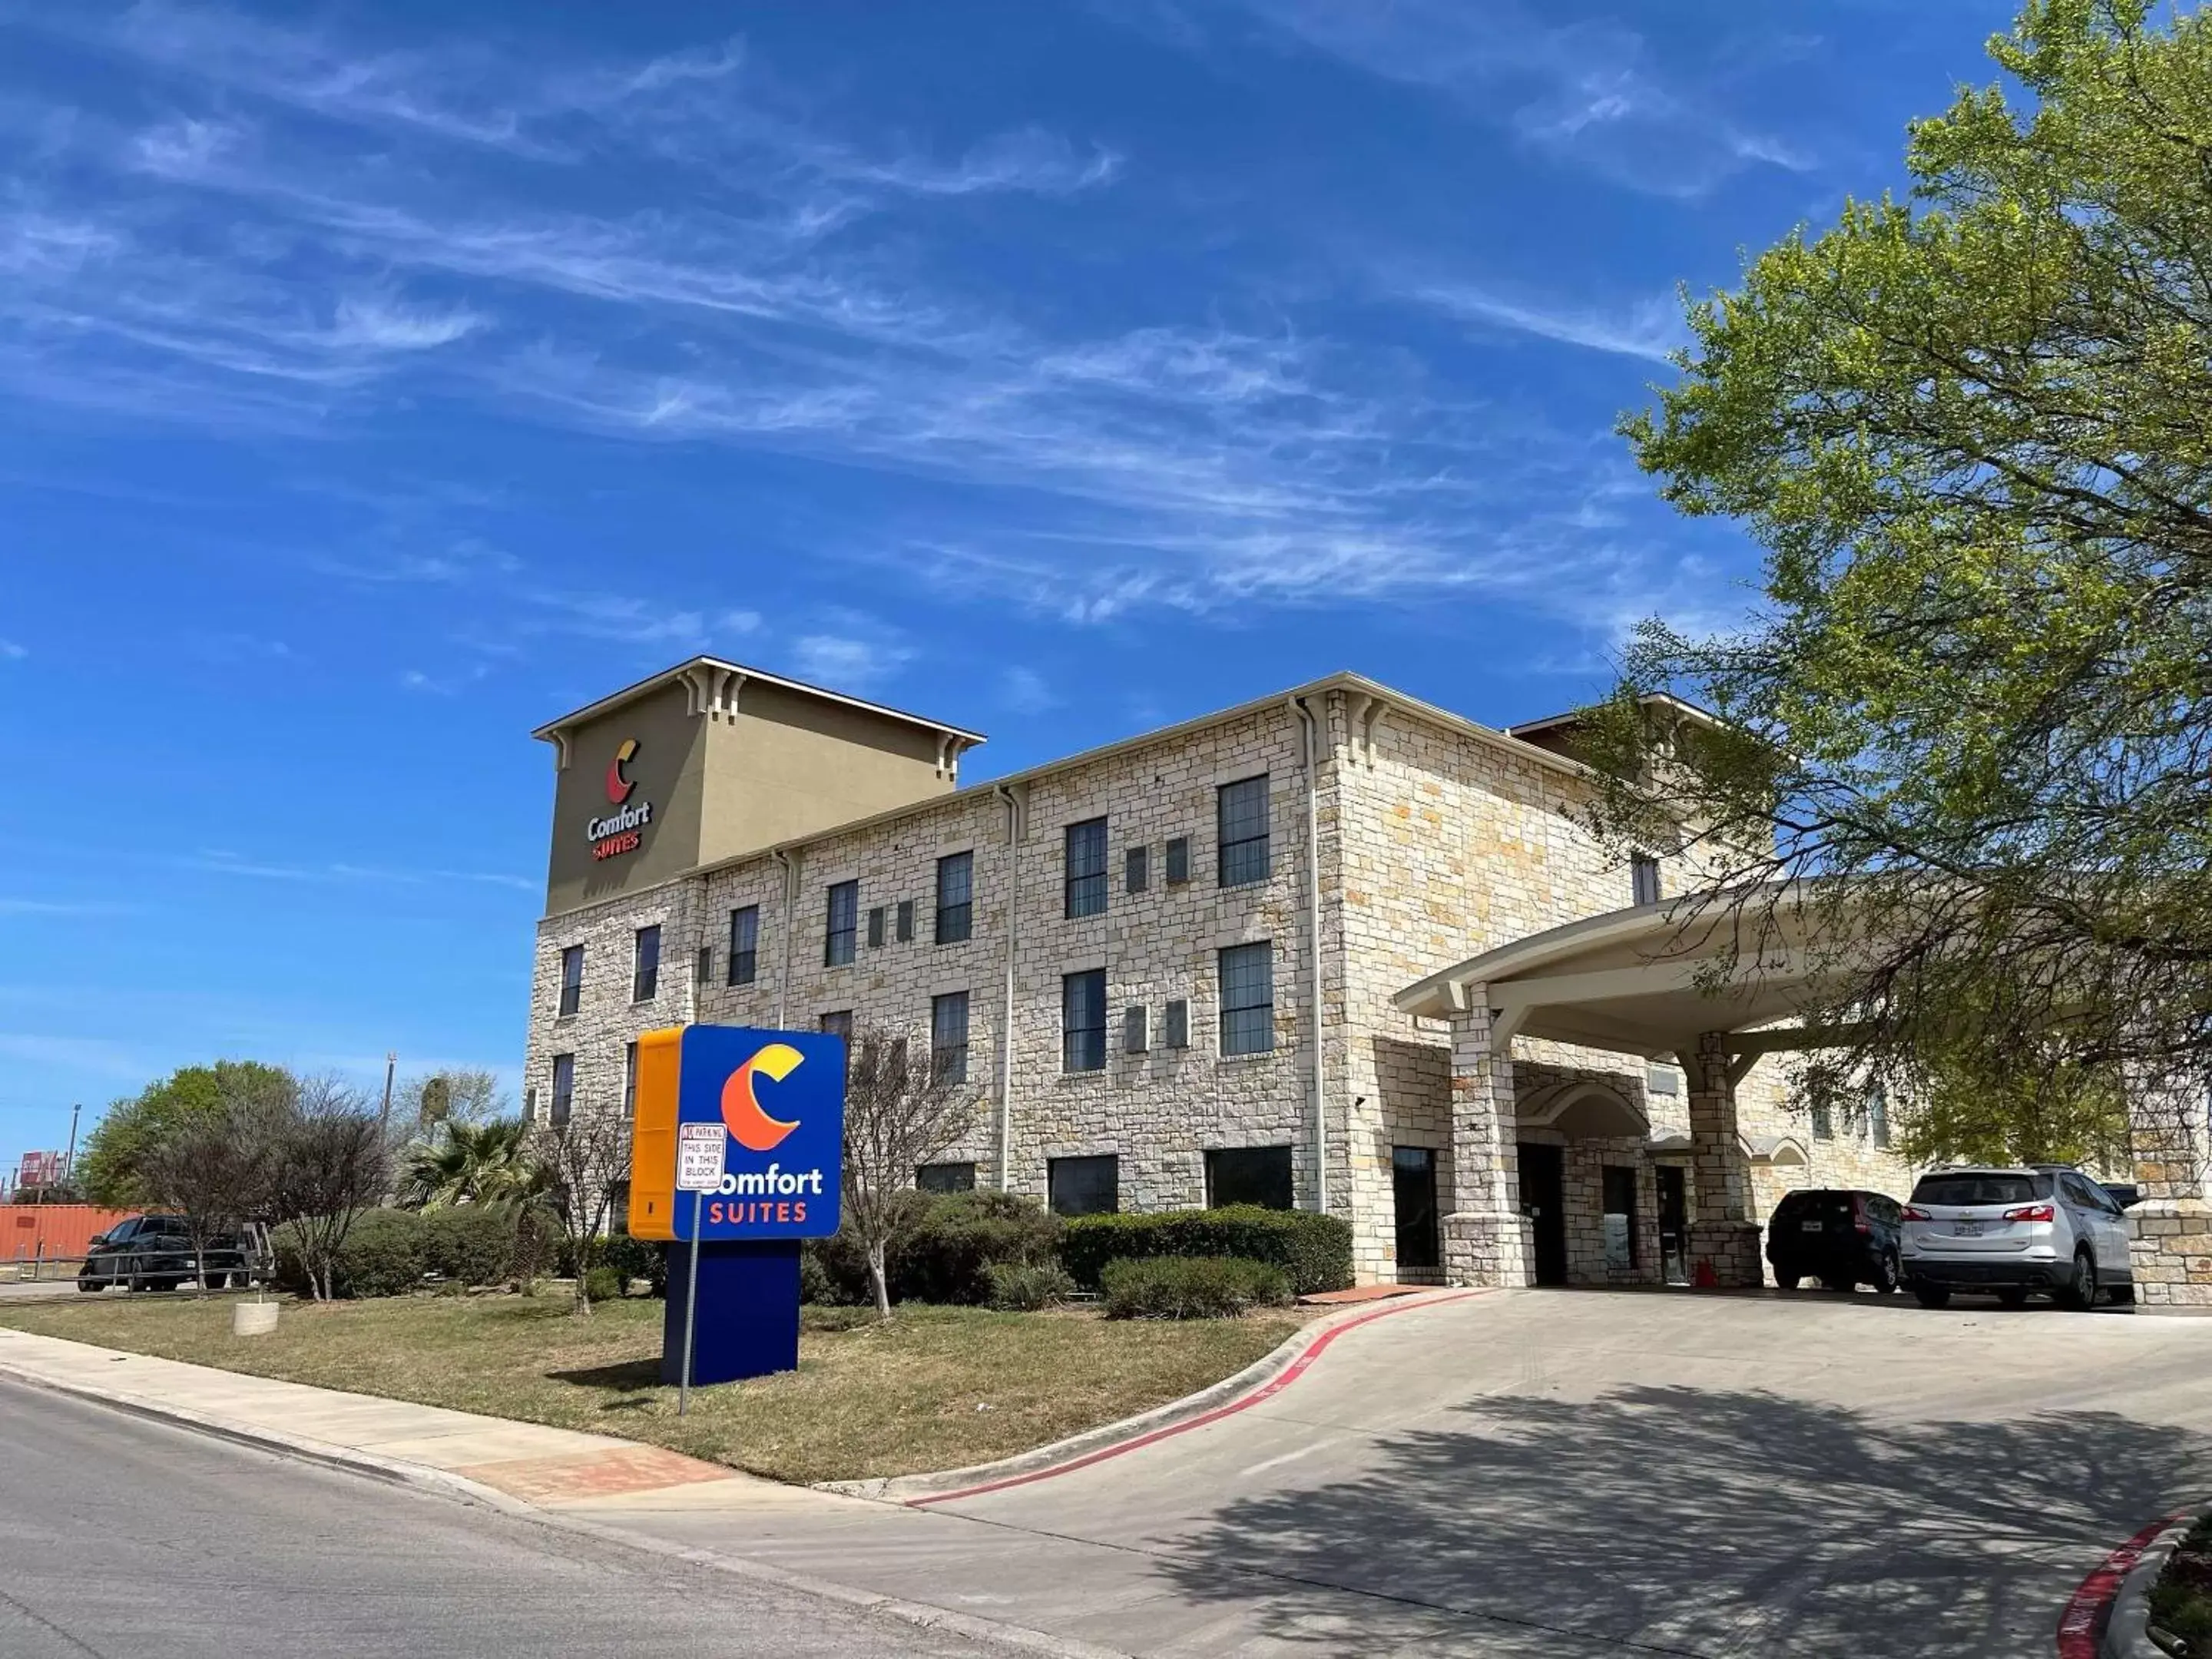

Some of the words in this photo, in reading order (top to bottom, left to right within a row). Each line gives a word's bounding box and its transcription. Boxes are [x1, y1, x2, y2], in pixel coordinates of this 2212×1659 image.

[588, 801, 651, 842] Comfort
[591, 831, 639, 860] SUITES
[684, 1143, 701, 1153] THIS
[704, 1143, 721, 1154] SIDE
[685, 1155, 694, 1164] IN
[699, 1155, 719, 1164] THIS
[686, 1167, 715, 1177] BLOCK
[701, 1163, 823, 1196] omfort
[710, 1202, 806, 1224] SUITES
